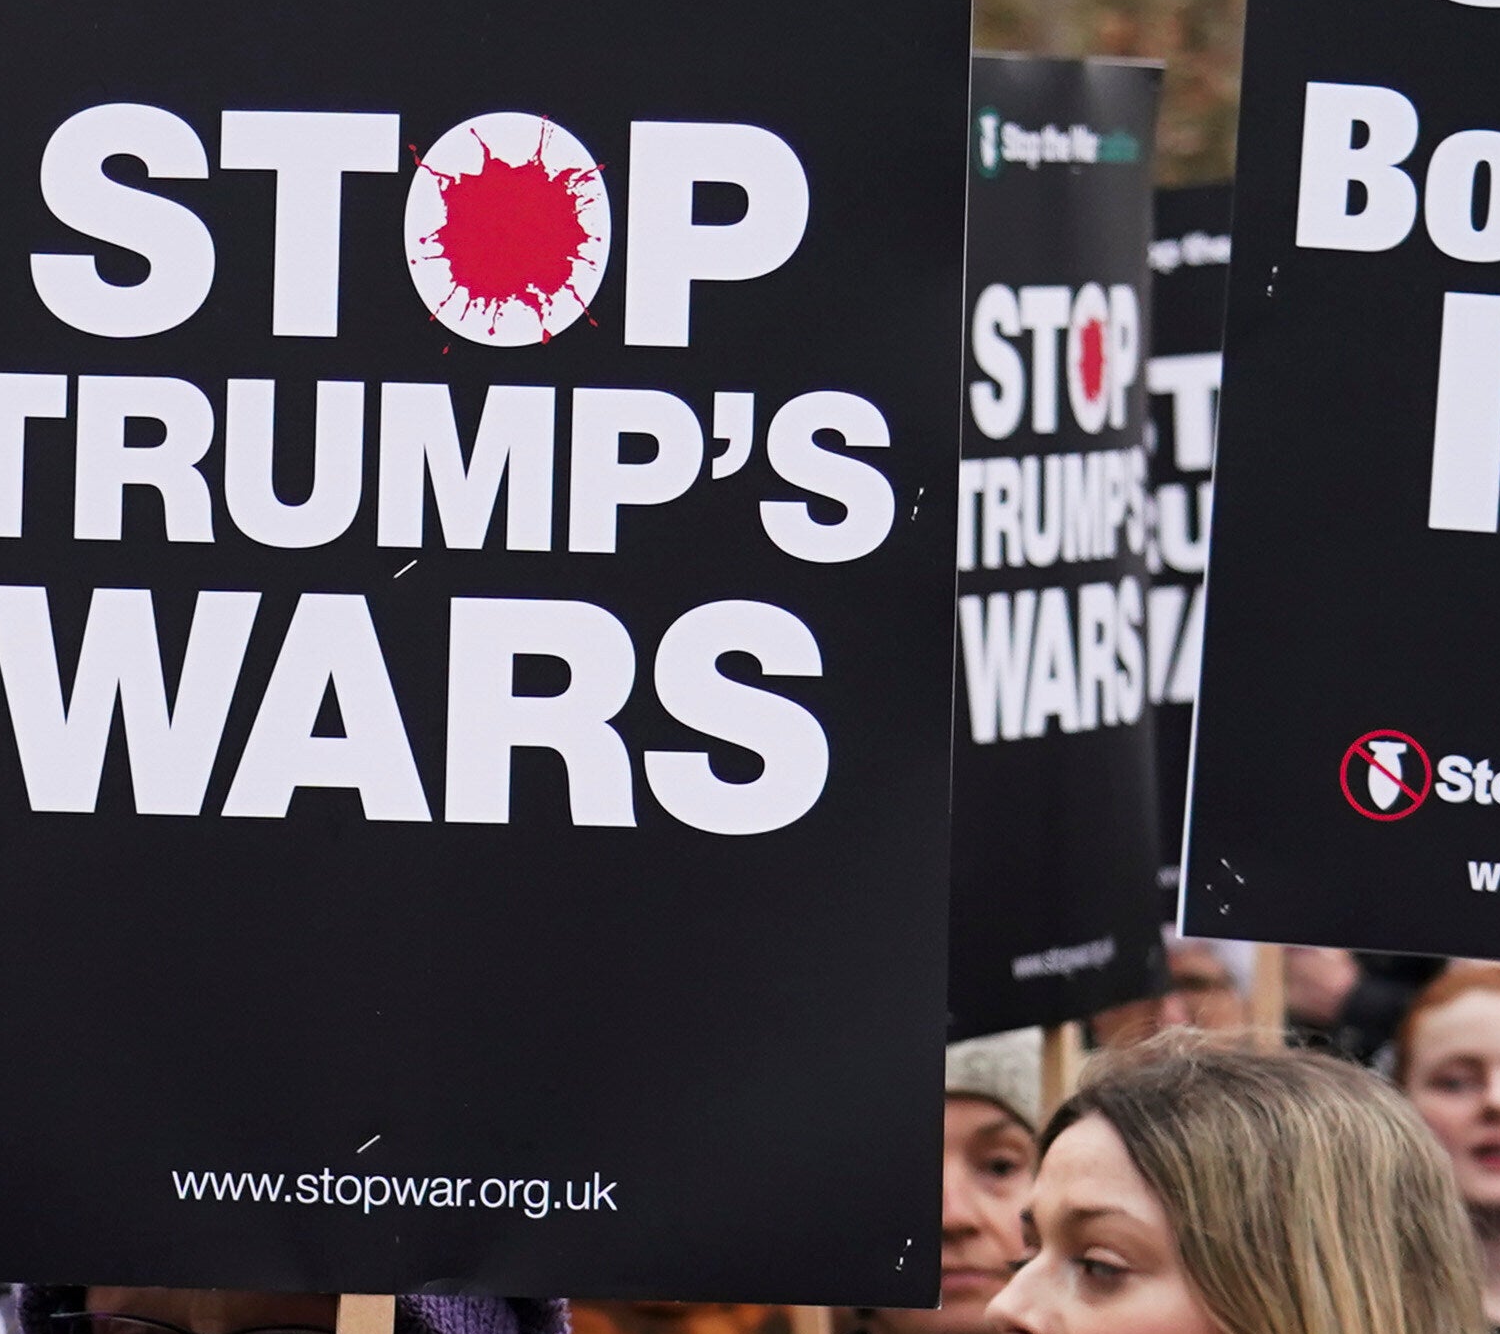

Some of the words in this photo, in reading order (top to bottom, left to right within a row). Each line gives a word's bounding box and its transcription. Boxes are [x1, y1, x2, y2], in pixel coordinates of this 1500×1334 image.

[29, 102, 810, 348] STOP
[969, 281, 1140, 440] STOP
[958, 573, 1147, 745] WARS
[171, 1167, 618, 1219] www.stopwar.org.uk
